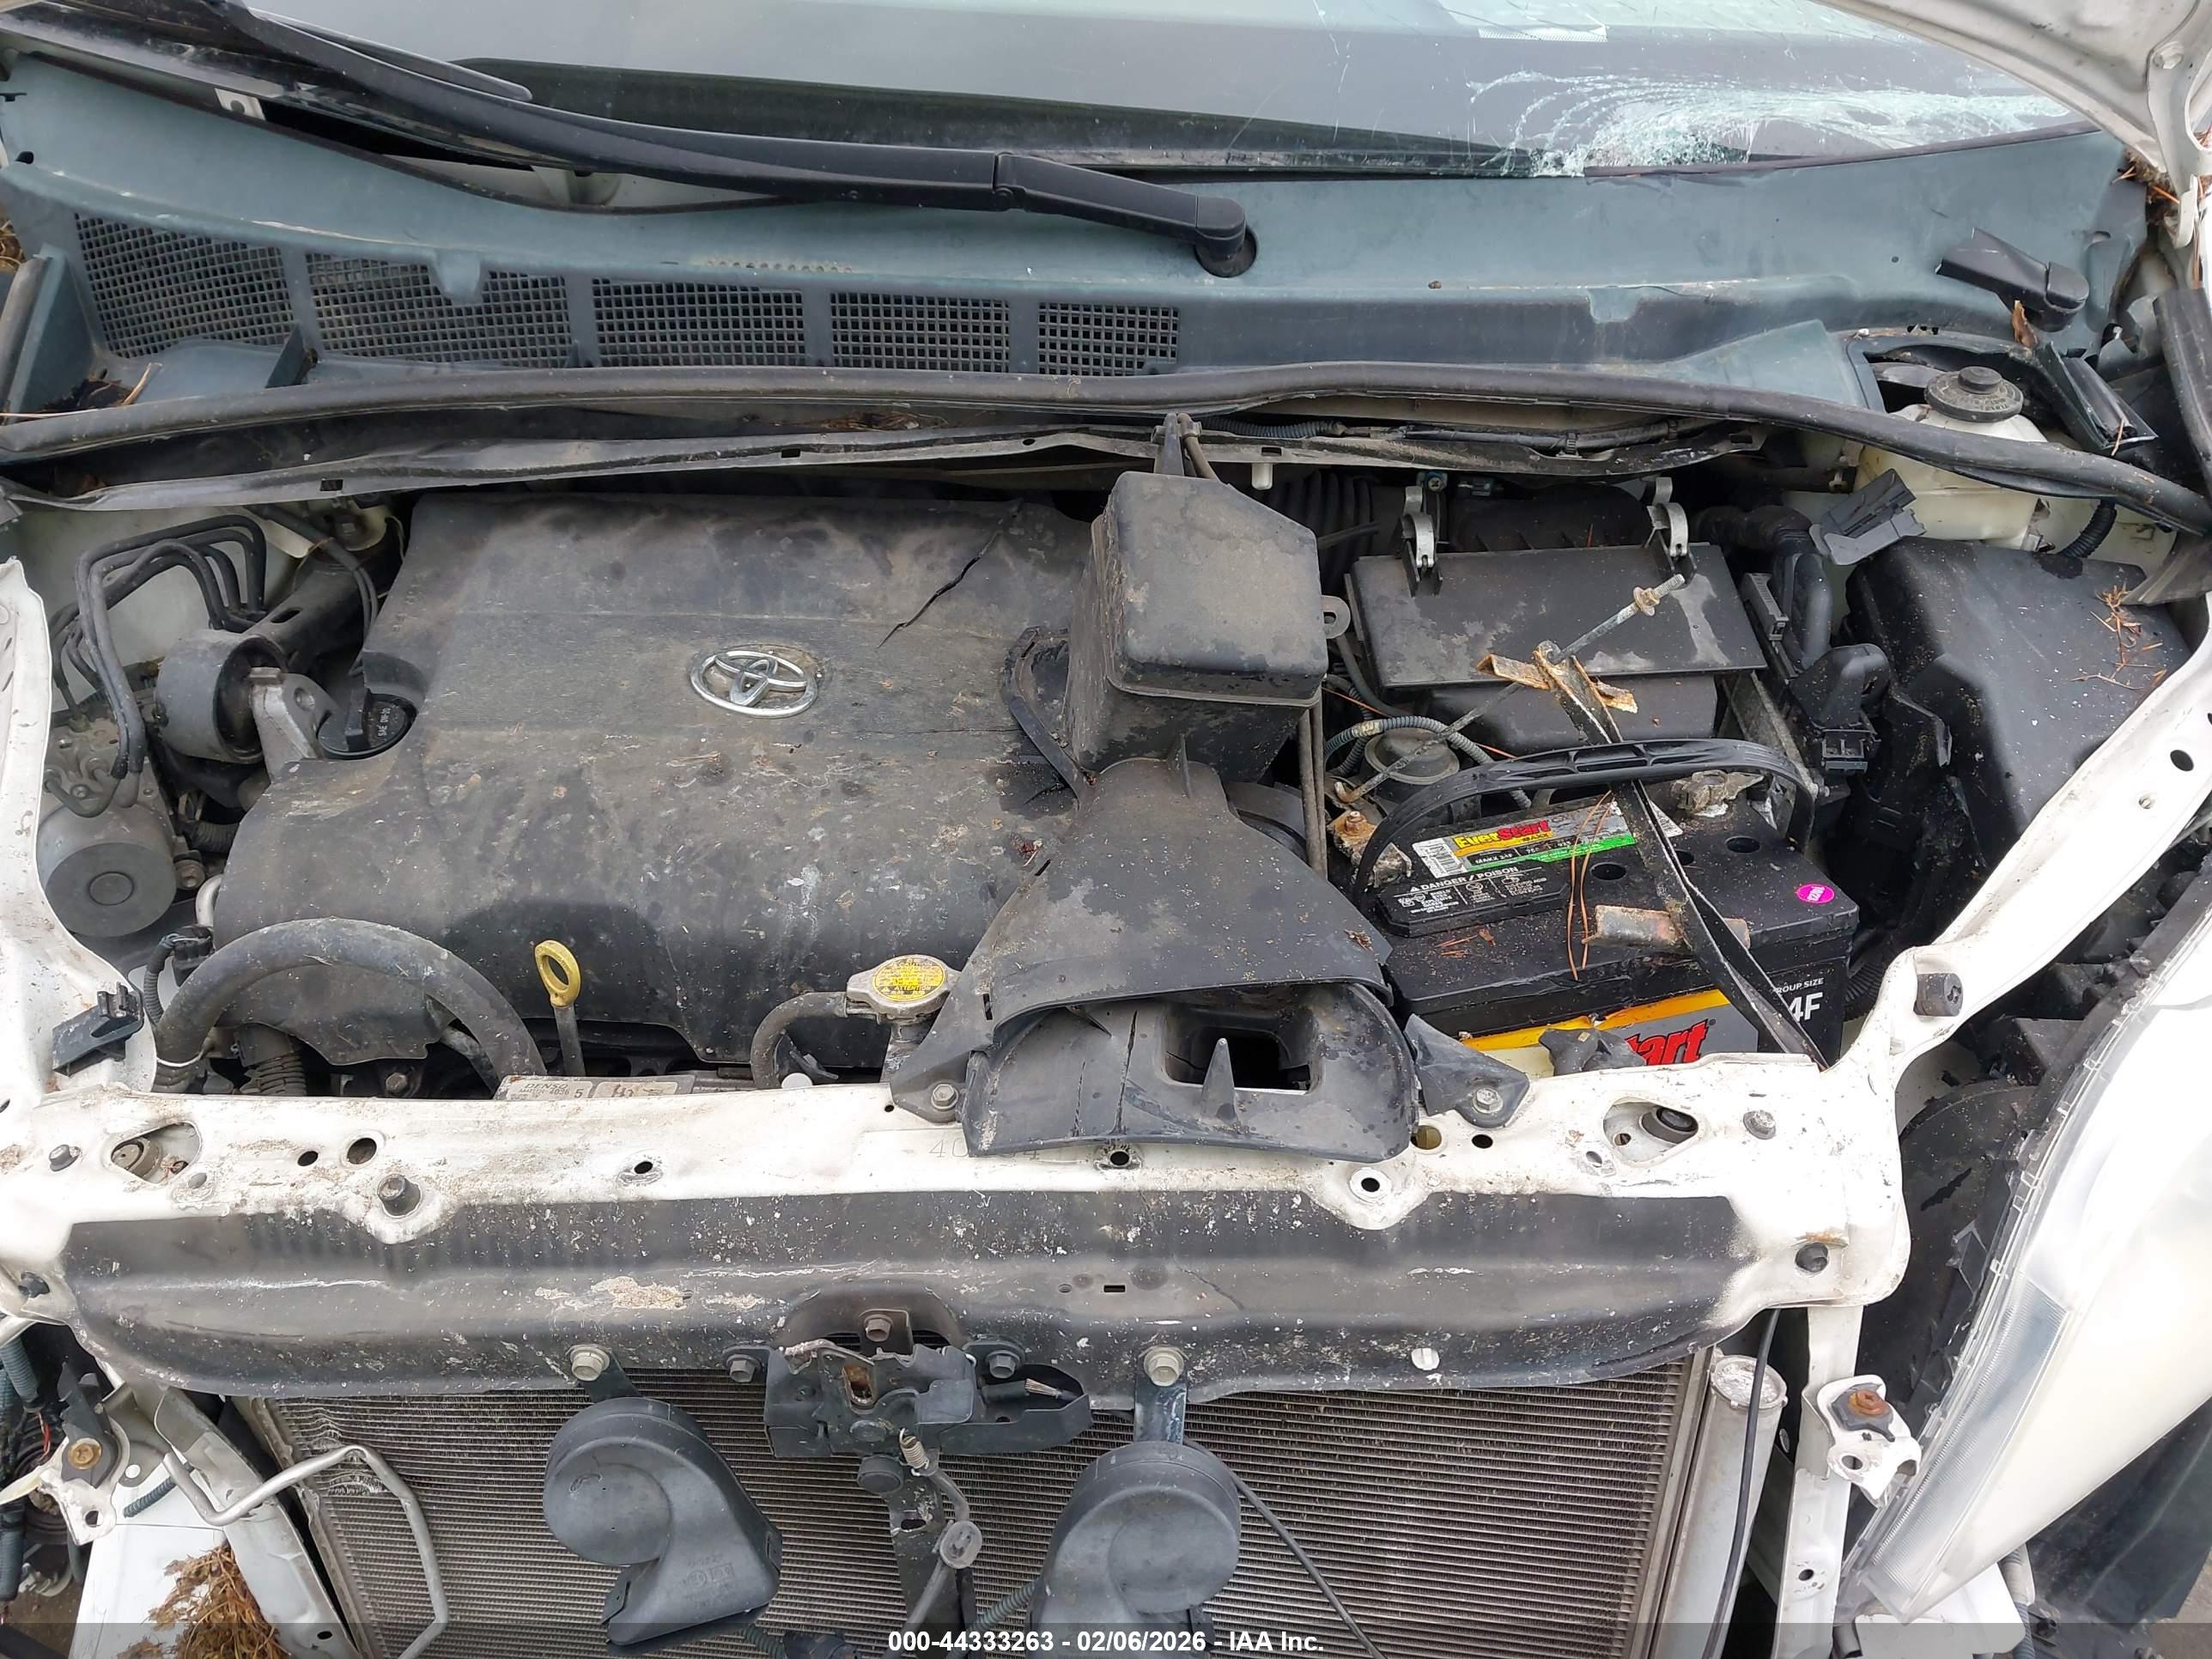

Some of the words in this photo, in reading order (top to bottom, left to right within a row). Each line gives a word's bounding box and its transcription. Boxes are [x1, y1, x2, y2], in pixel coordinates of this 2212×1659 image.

[1453, 820, 1550, 848] EverStart
[1420, 877, 1467, 891] DANGER
[1476, 866, 1519, 880] POISON
[1774, 982, 1802, 994] ROUP
[1803, 977, 1824, 988] SIZE
[574, 1088, 585, 1099] 5
